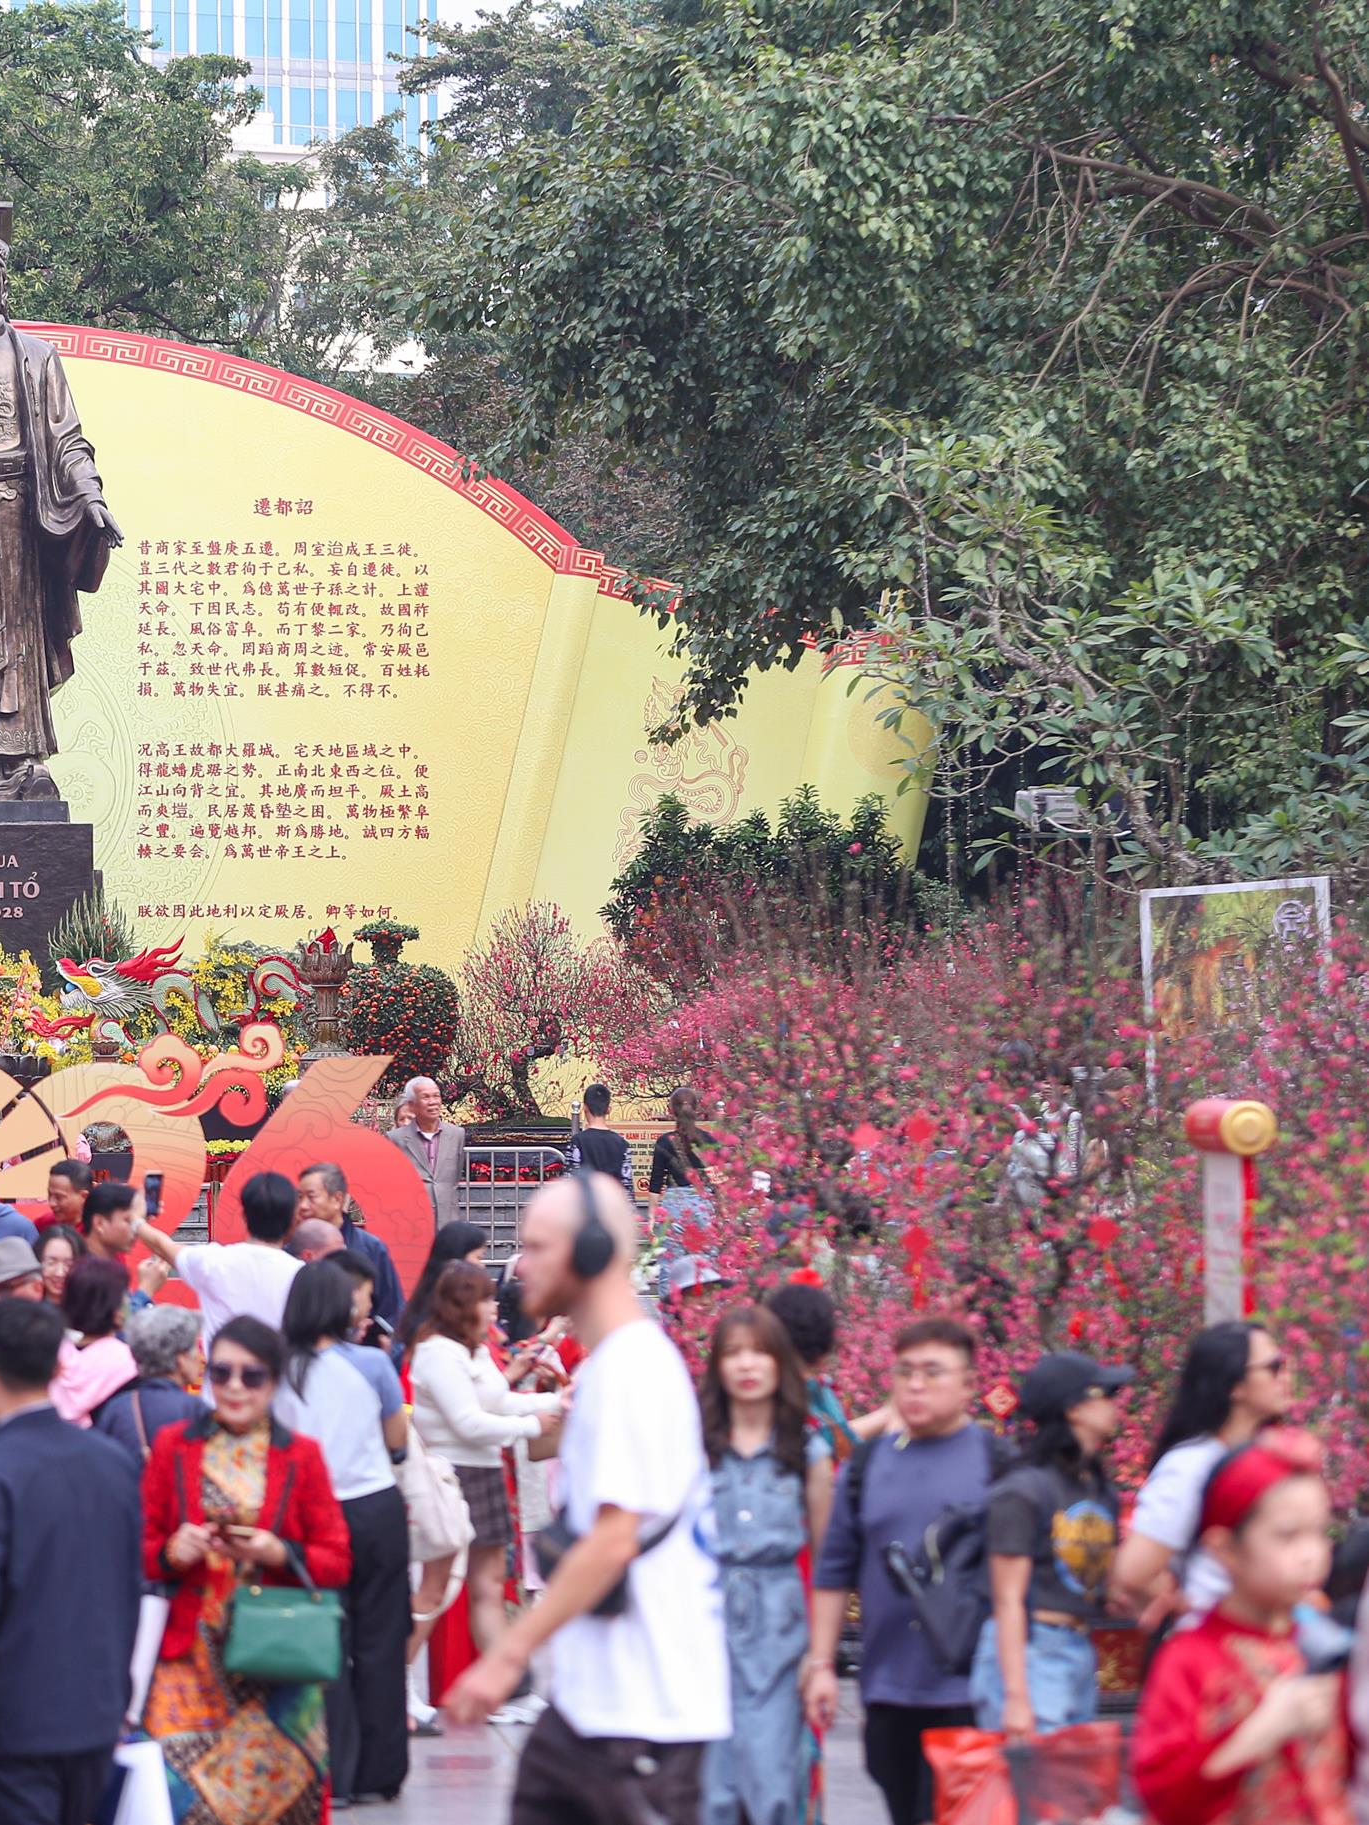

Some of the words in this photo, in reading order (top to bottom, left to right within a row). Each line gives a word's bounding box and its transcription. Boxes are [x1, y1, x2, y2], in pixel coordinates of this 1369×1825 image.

[253, 497, 315, 516] 遷都詔
[9, 872, 41, 899] TỔ
